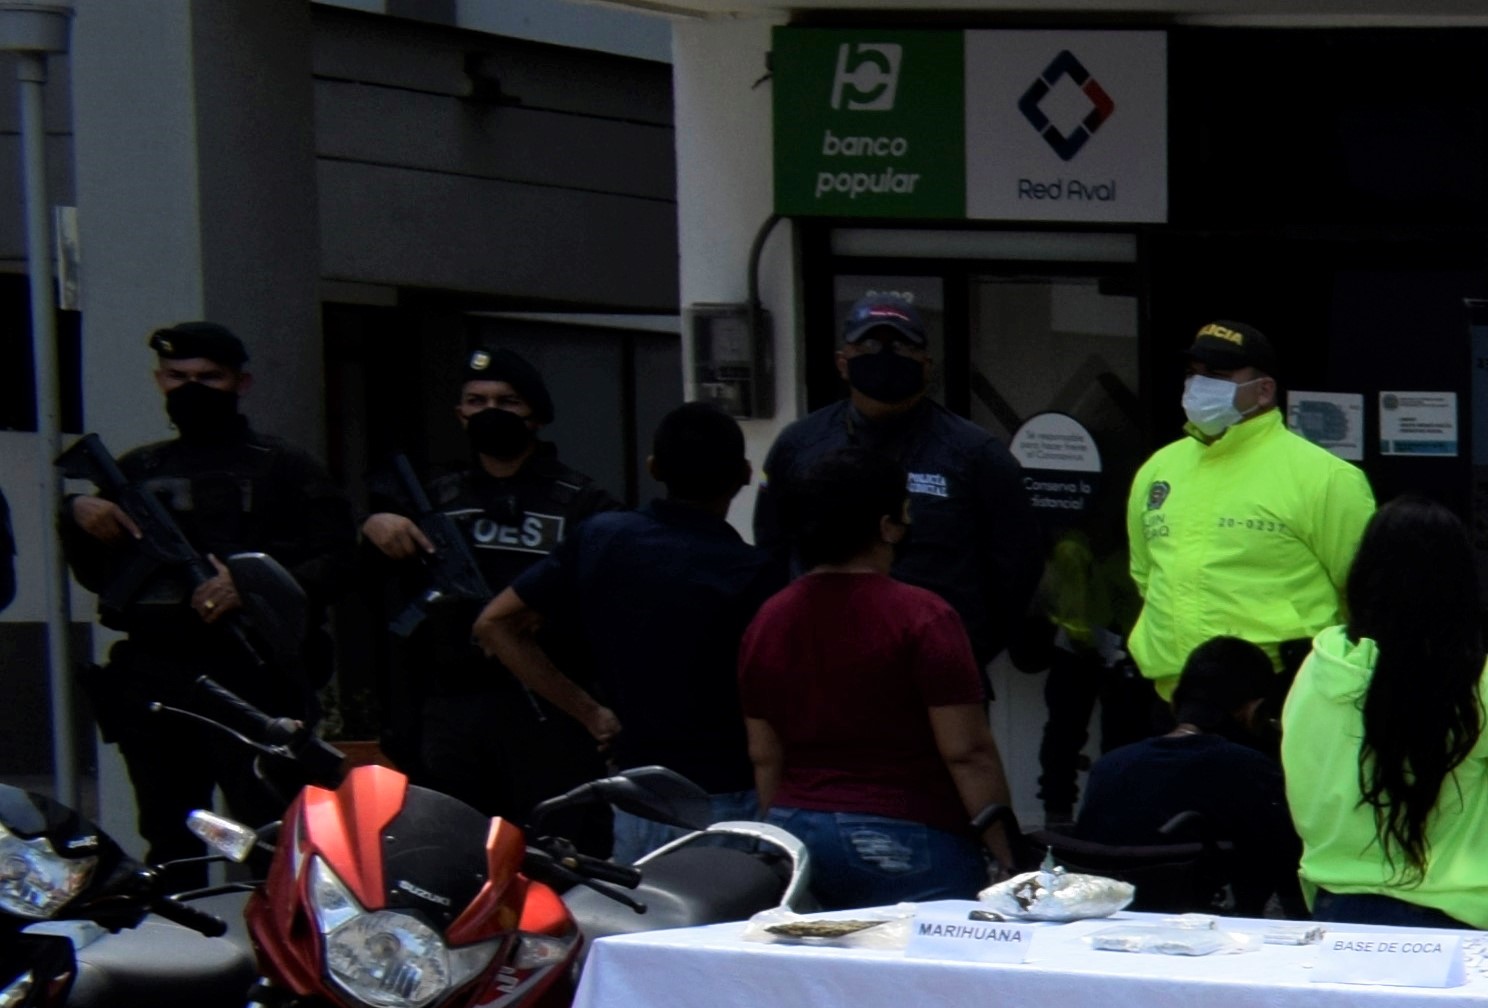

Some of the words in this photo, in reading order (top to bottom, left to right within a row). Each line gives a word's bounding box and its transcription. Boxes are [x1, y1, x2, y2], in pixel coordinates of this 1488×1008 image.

[822, 130, 908, 158] banco
[815, 167, 922, 199] popular
[1019, 180, 1062, 200] Red
[1068, 180, 1116, 201] Aval
[1199, 323, 1245, 346] LICIA
[473, 516, 543, 547] OES
[399, 880, 450, 906] SUZUKI
[918, 922, 1022, 943] MARIHUANA
[1333, 939, 1374, 952] BASE
[1378, 941, 1398, 953] DE
[1401, 941, 1443, 954] COCA
